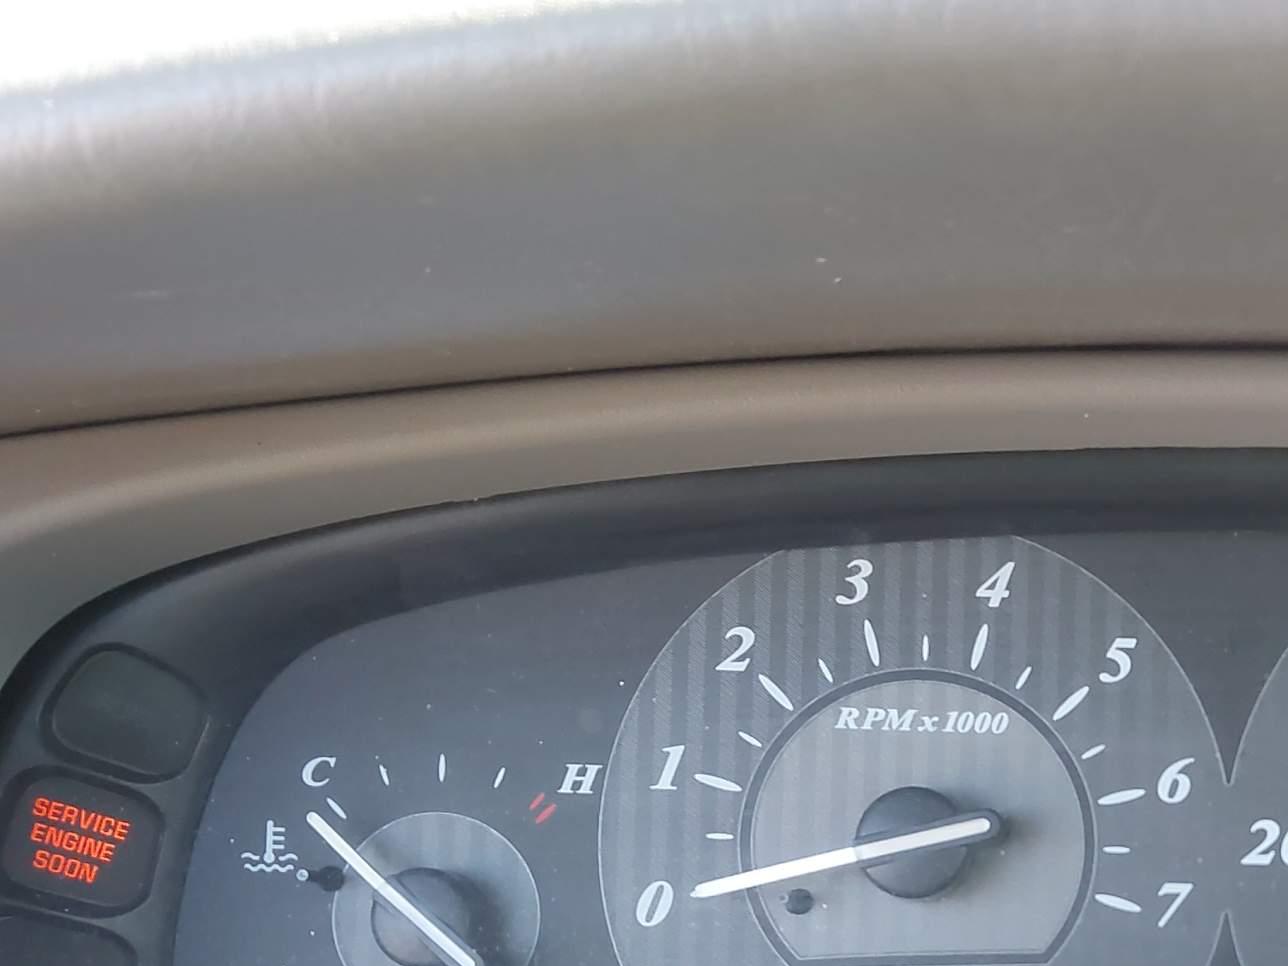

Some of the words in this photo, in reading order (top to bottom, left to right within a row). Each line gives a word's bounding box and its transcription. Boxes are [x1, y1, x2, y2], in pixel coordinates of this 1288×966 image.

[836, 559, 873, 604] 3
[975, 562, 1015, 607] 4
[715, 627, 755, 671] 2
[1099, 638, 1137, 682] 5
[834, 706, 918, 732] RPM
[939, 711, 1009, 735] 1000
[302, 756, 336, 787] C
[557, 764, 602, 795] H
[649, 745, 685, 790] 1
[1157, 758, 1195, 803] 6
[31, 797, 131, 842] SERVICE
[30, 823, 116, 863] ENGINE
[32, 850, 99, 884] SOON
[635, 881, 674, 926] 0
[1157, 883, 1193, 927] 7
